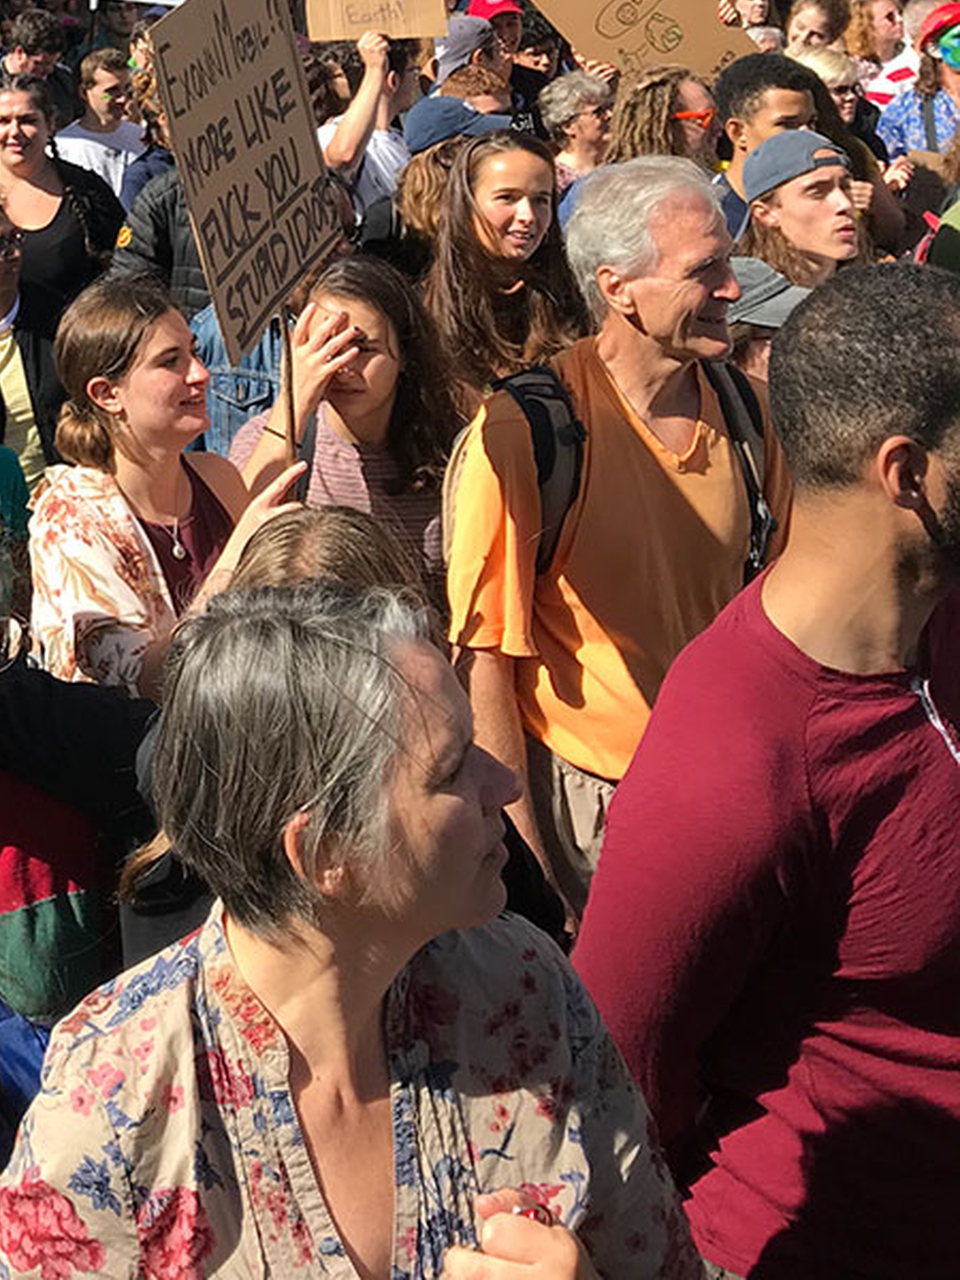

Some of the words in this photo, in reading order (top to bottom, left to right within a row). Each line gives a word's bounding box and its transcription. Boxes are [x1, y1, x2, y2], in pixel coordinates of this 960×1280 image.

[183, 116, 237, 197] MORE
[234, 68, 298, 149] LIKE
[200, 183, 262, 270] FUCK
[255, 136, 301, 229] YOU
[226, 232, 290, 342] STUPID
